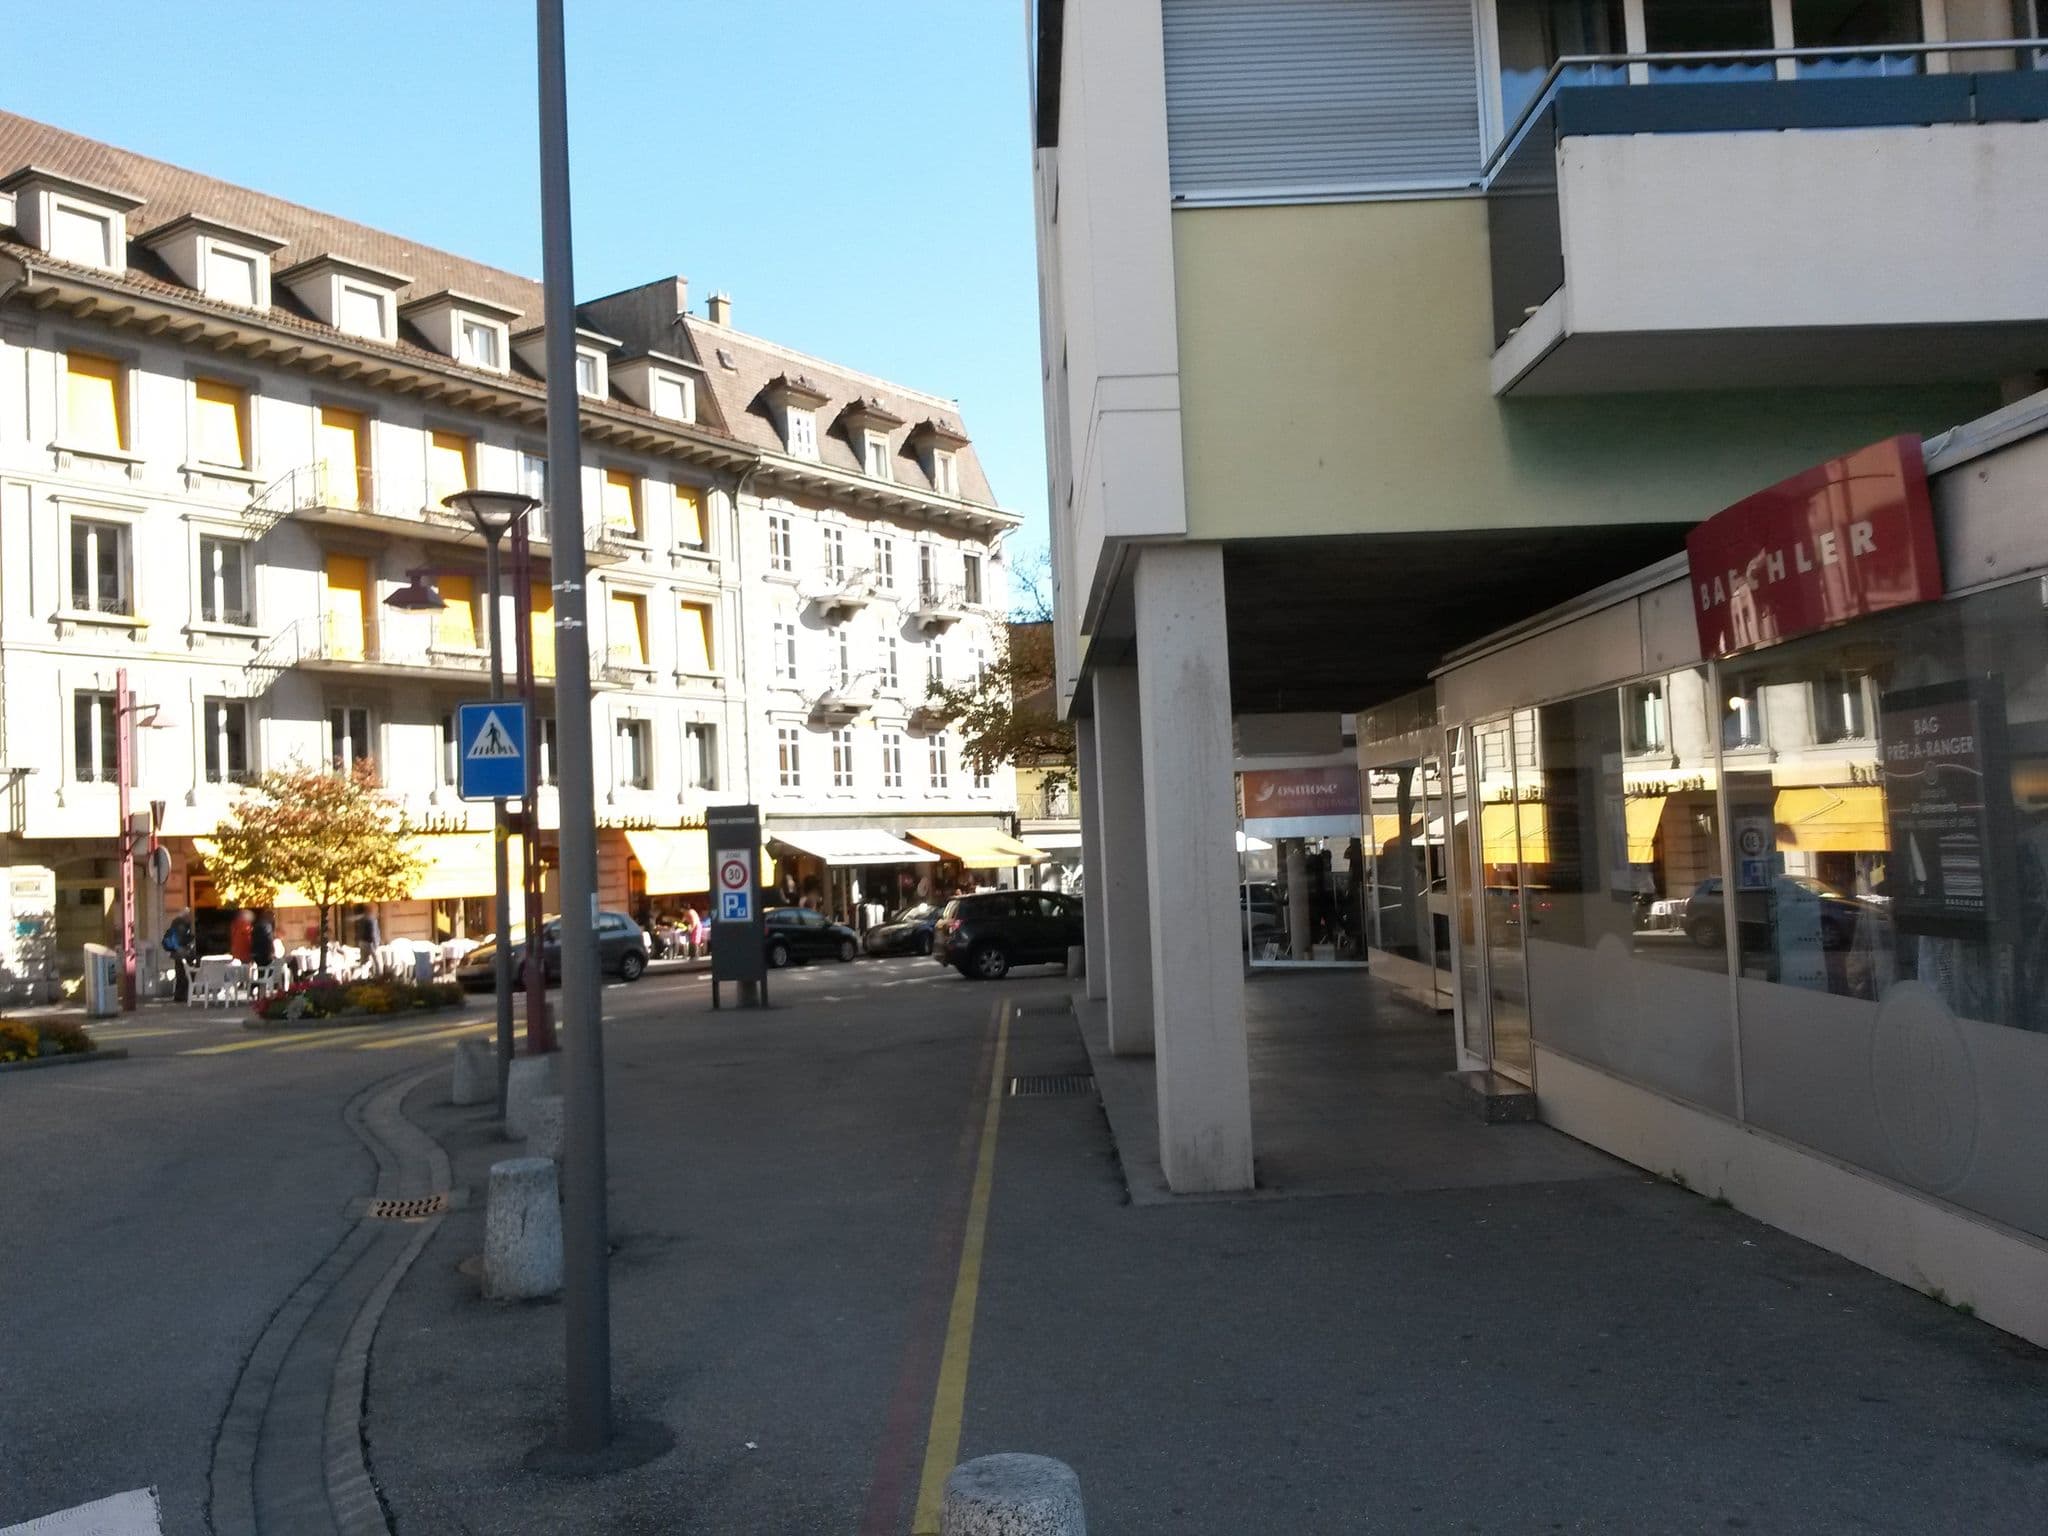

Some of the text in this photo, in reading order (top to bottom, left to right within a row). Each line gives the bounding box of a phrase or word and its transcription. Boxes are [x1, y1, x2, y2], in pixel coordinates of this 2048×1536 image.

[1700, 520, 1877, 611] BAECHLER
[1914, 716, 1939, 736] BAG
[728, 868, 741, 880] 30
